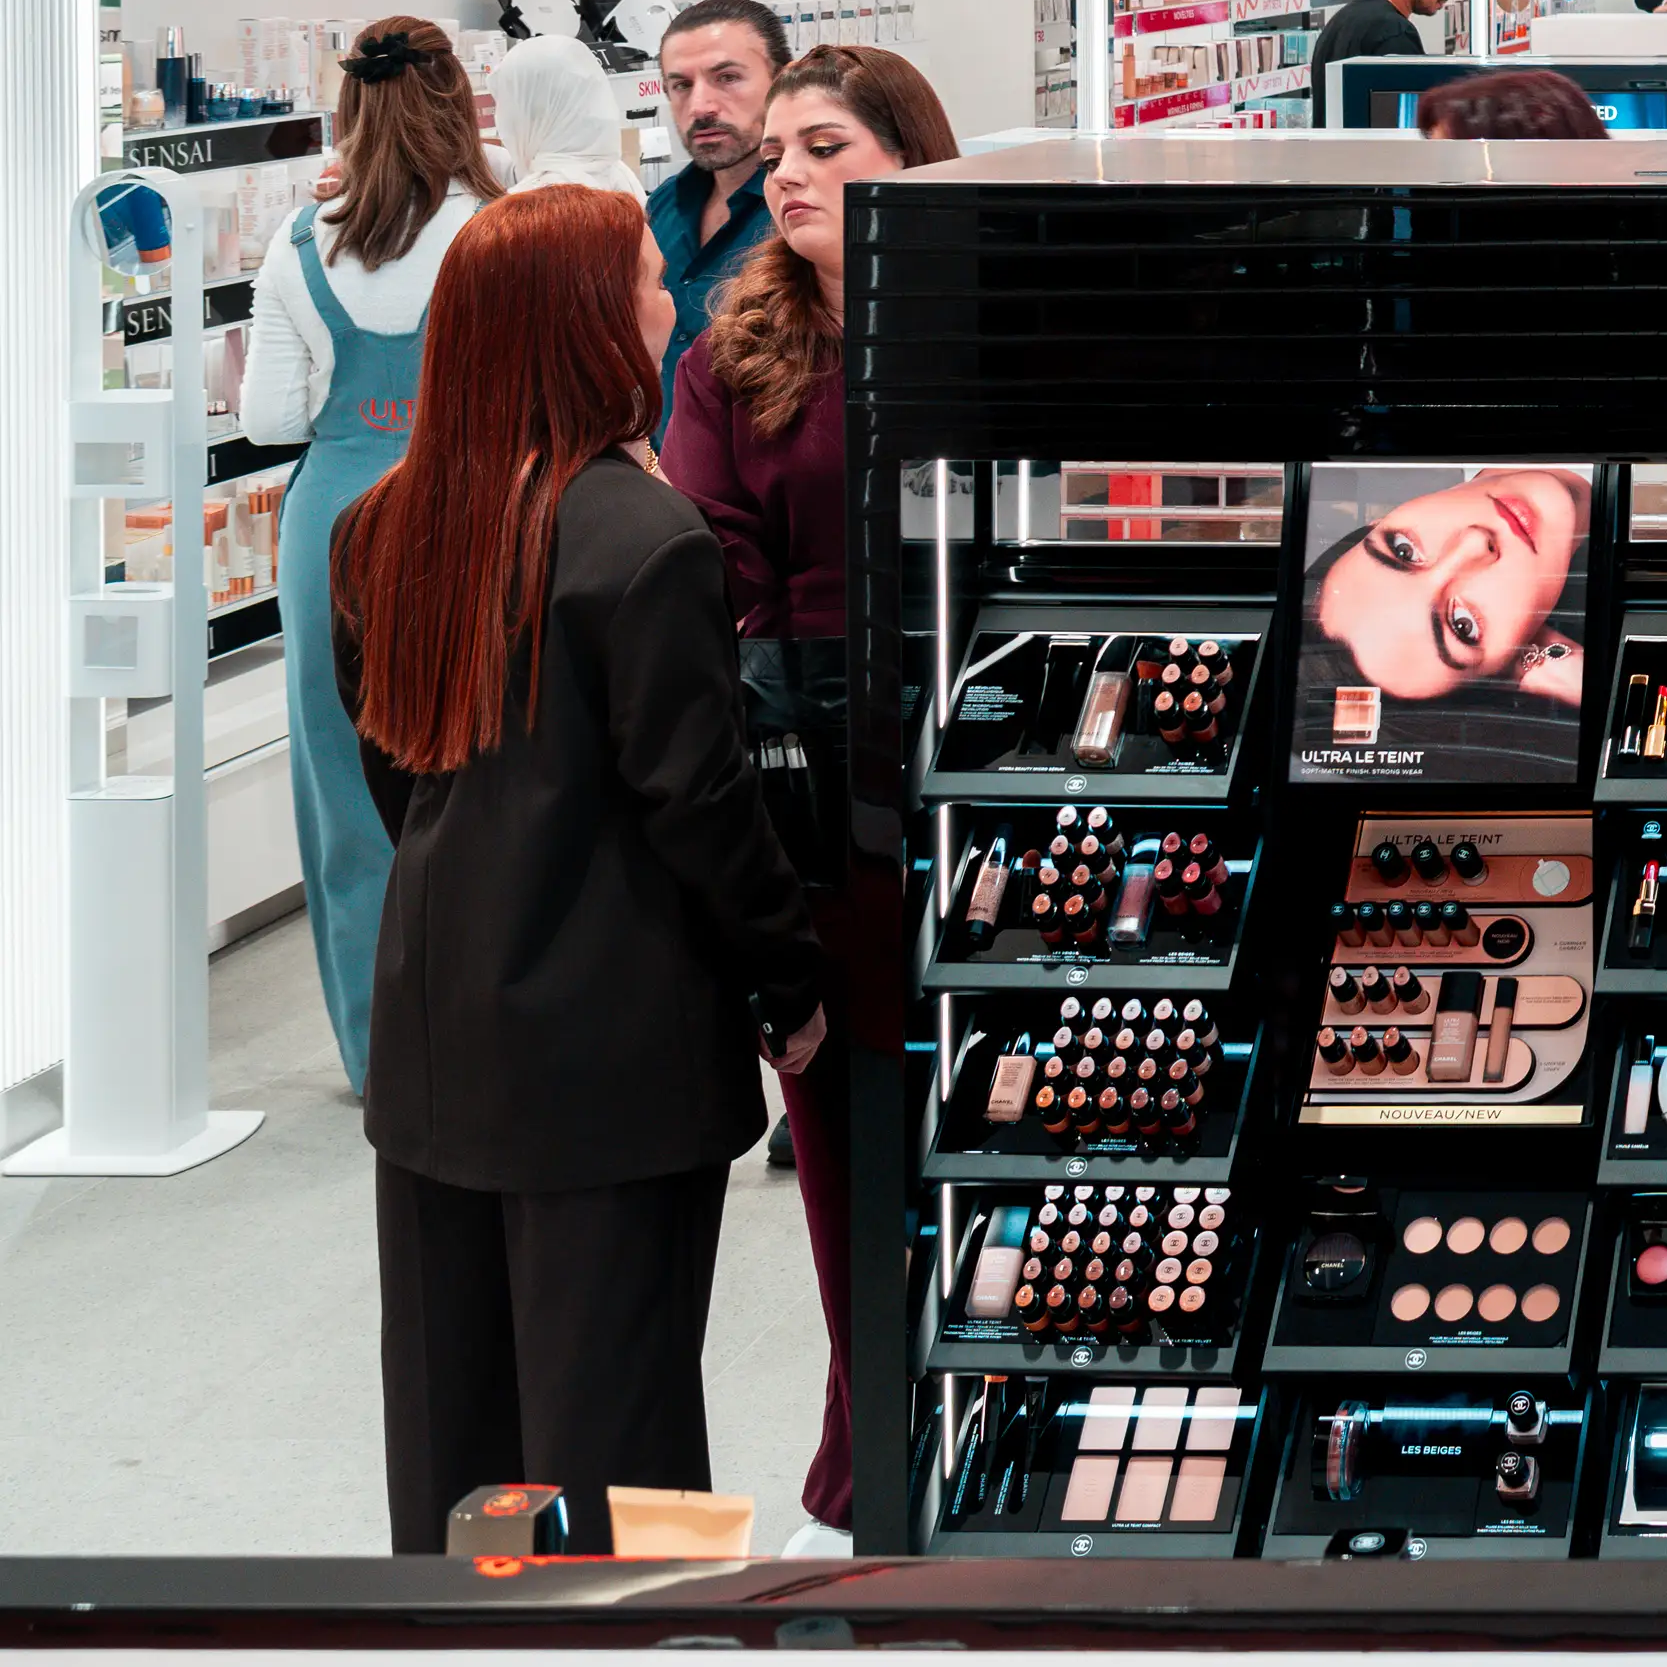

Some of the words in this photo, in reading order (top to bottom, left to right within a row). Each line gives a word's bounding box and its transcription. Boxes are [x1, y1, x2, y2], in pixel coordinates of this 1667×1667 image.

[638, 81, 661, 98] SKIN
[129, 139, 213, 168] SENSAI
[1301, 750, 1352, 763] ULTRA
[1355, 751, 1374, 763] LE
[1377, 751, 1424, 763] TEINT
[1385, 835, 1432, 845] ULTRA
[1437, 835, 1456, 845] LE
[1460, 835, 1502, 845] TEINT
[1380, 1109, 1502, 1120] NOUVEAU/NEW
[1401, 1445, 1421, 1454] LES
[1423, 1446, 1461, 1455] BEIGES
[1022, 1473, 1030, 1501] CHANEL
